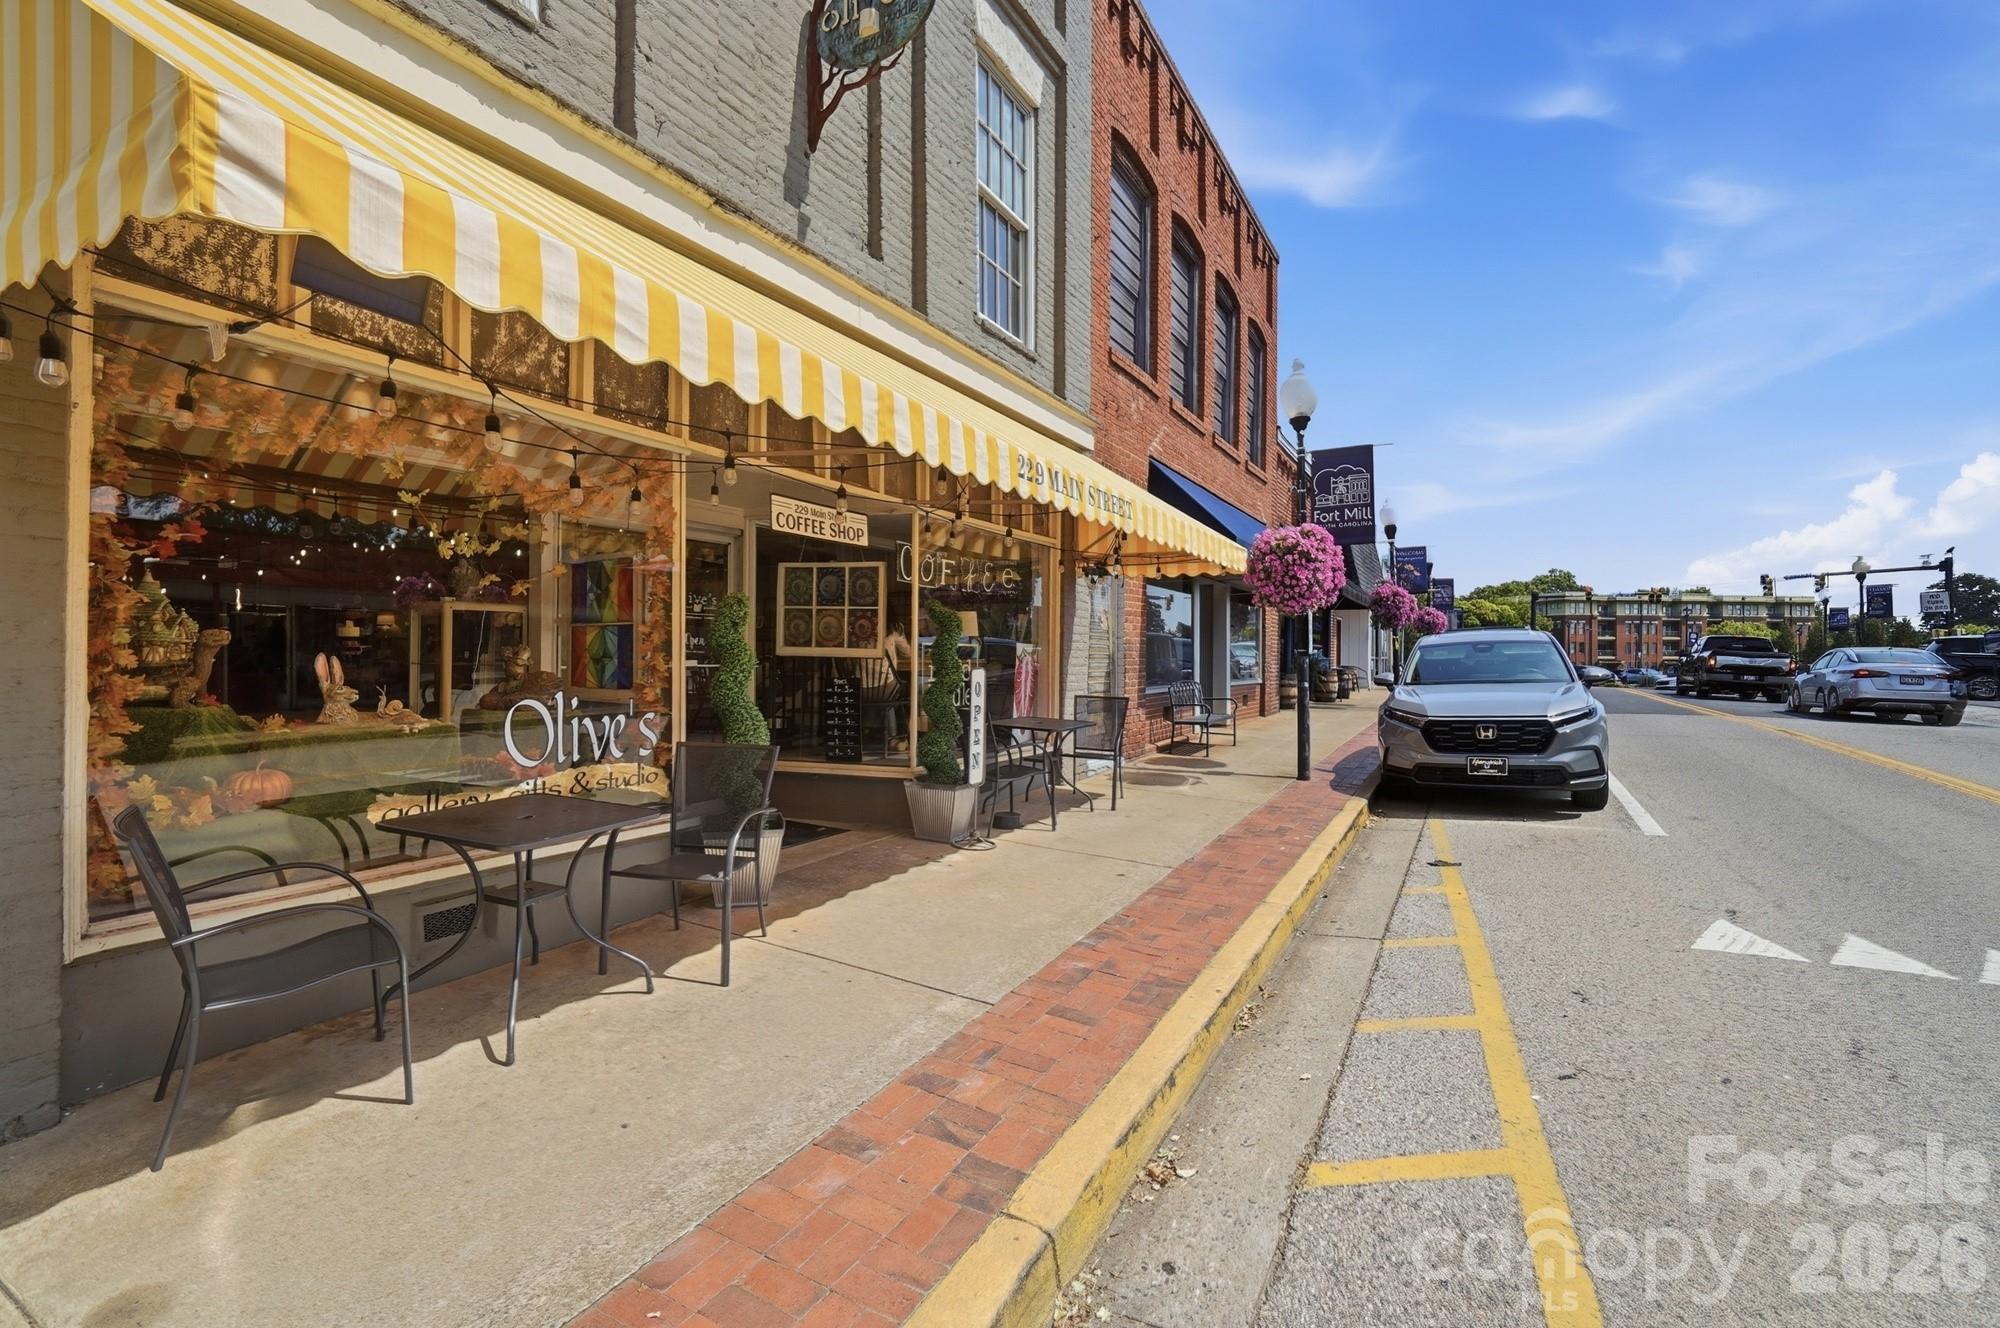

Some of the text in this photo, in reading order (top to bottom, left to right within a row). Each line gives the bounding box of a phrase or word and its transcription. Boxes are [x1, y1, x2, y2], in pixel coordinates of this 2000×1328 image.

[1018, 454, 1133, 520] 229 MAIN STREET
[776, 512, 865, 542] COFFEE SHOP
[794, 504, 848, 523] 229 Main Stt
[1313, 506, 1373, 523] Fort Mill
[504, 690, 660, 768] Olive's
[972, 681, 982, 769] OPEN
[569, 771, 593, 795] &
[596, 763, 659, 791] studio
